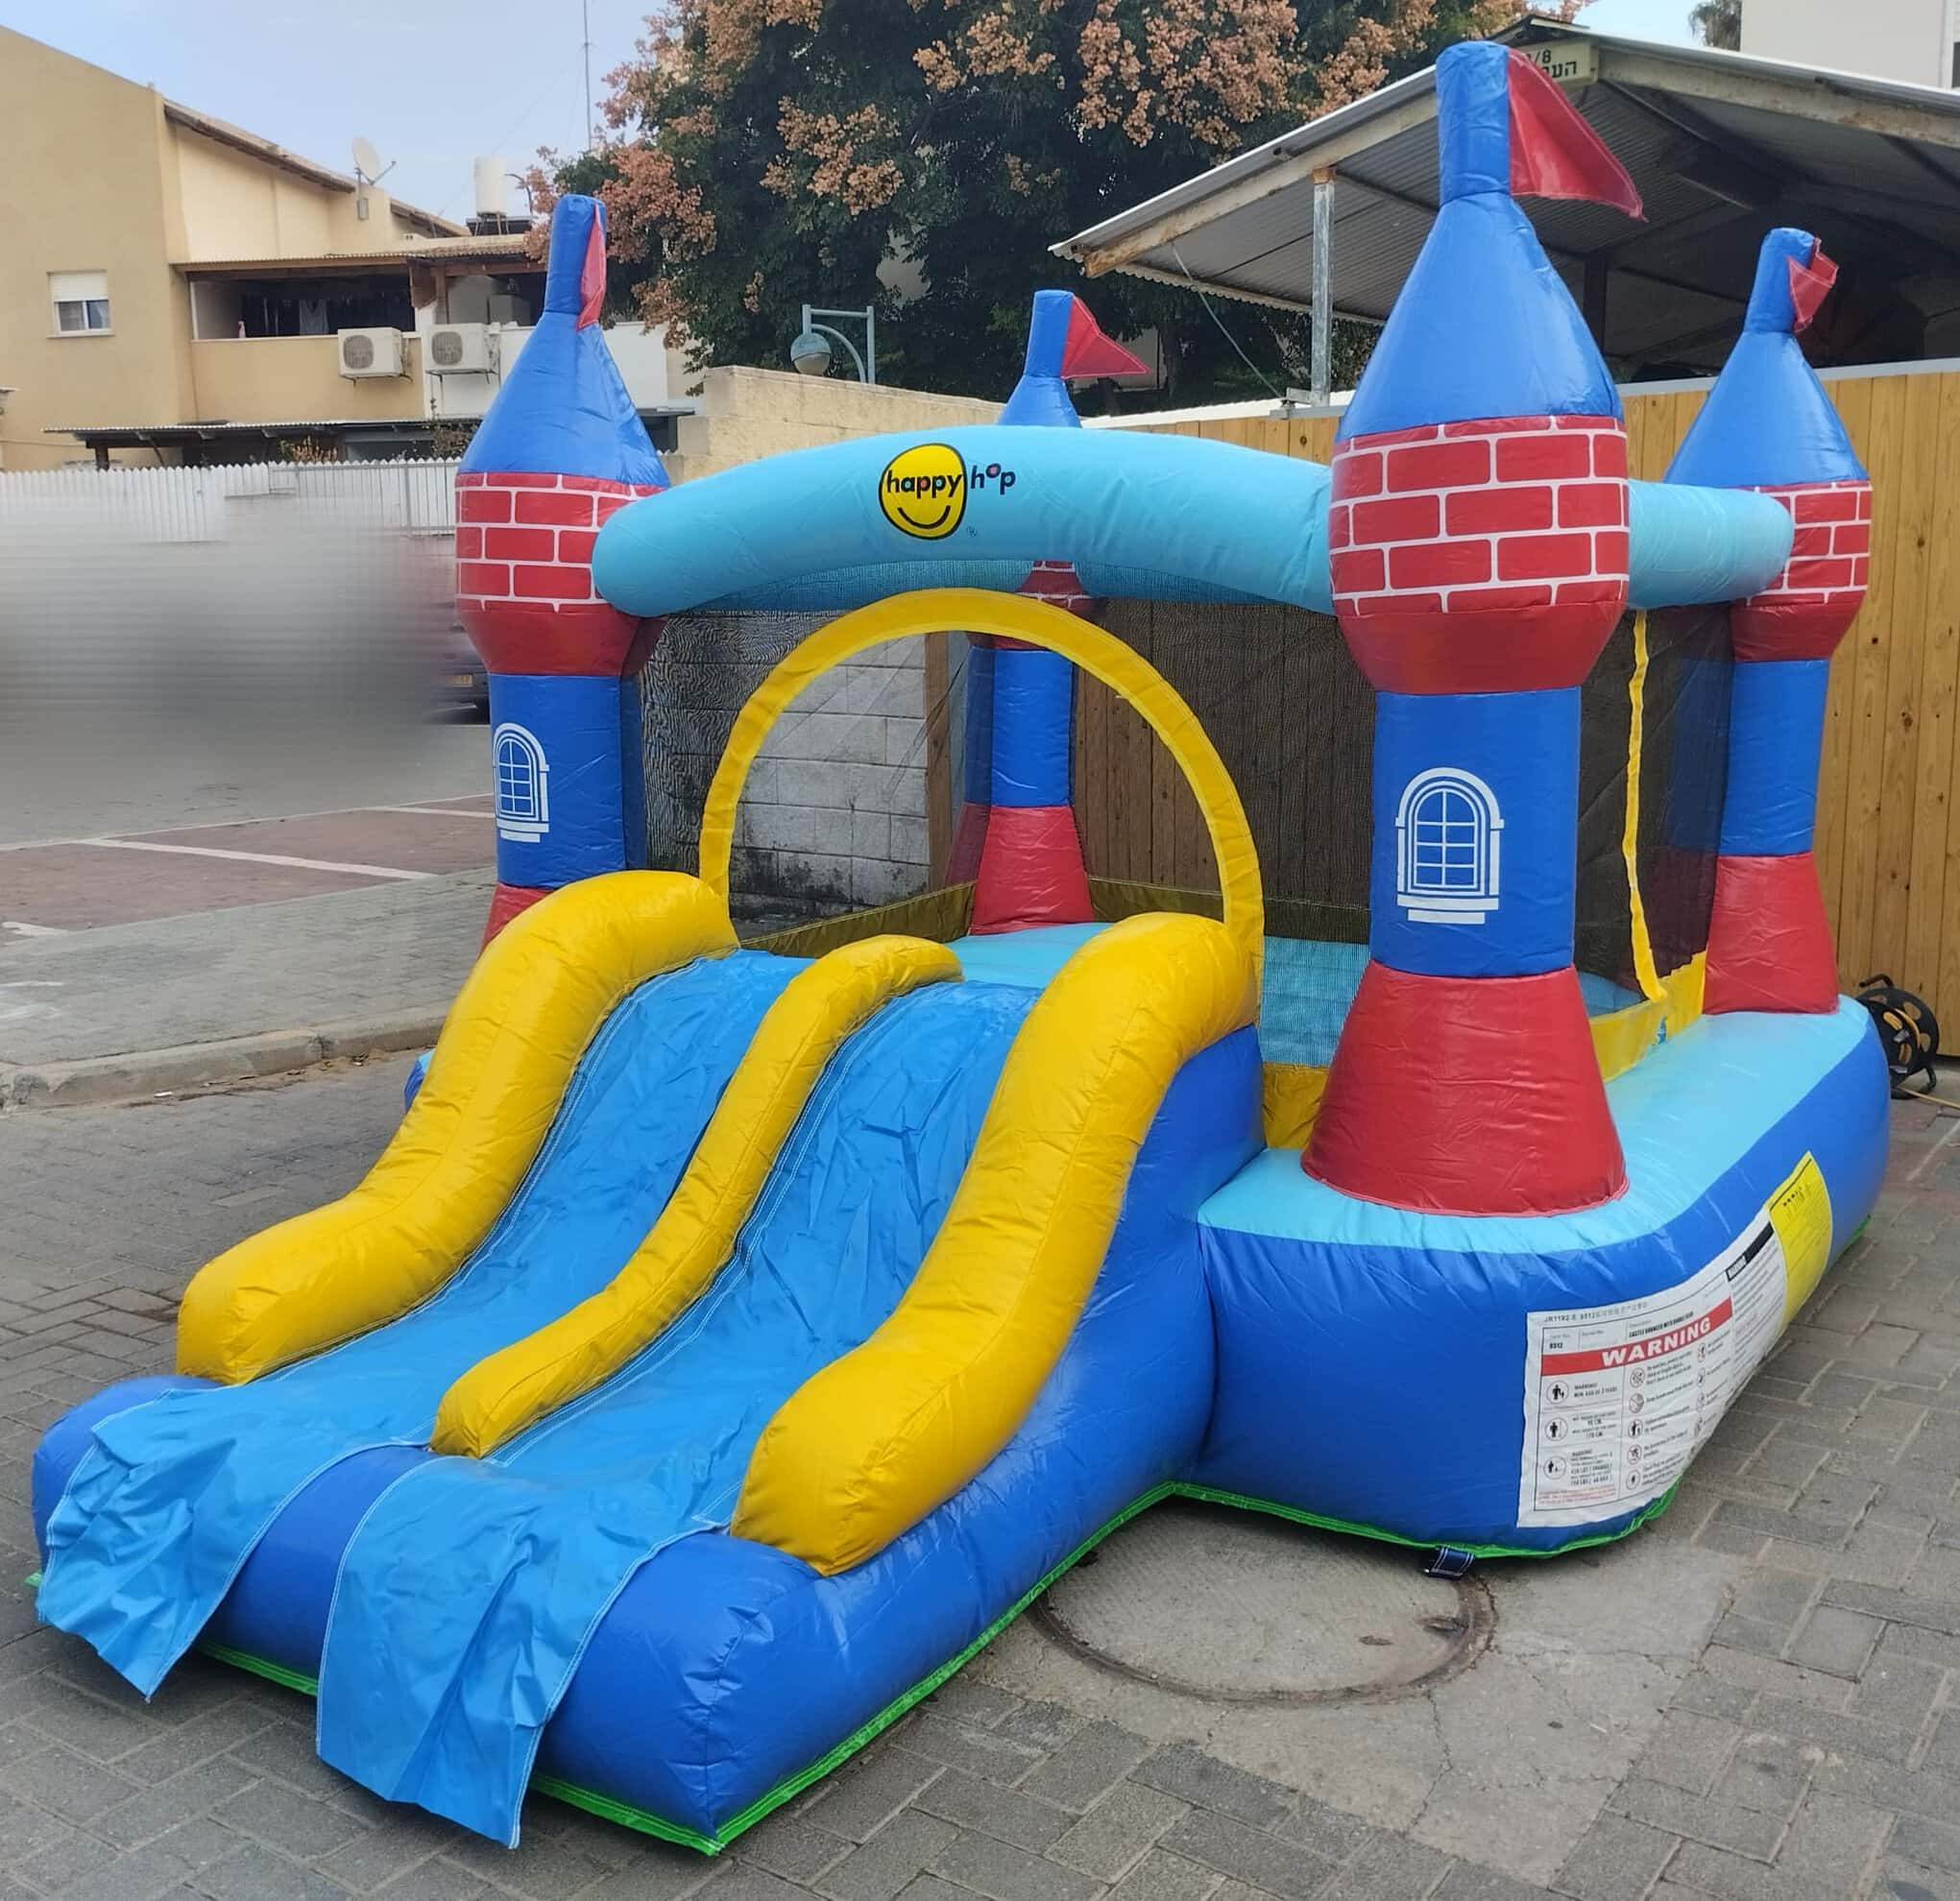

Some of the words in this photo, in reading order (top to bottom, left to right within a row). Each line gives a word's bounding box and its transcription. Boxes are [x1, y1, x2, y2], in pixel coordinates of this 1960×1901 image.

[1527, 49, 1552, 63] /8
[886, 469, 963, 499] happy
[970, 463, 1016, 495] hop
[1602, 1316, 1710, 1366] WARNING
